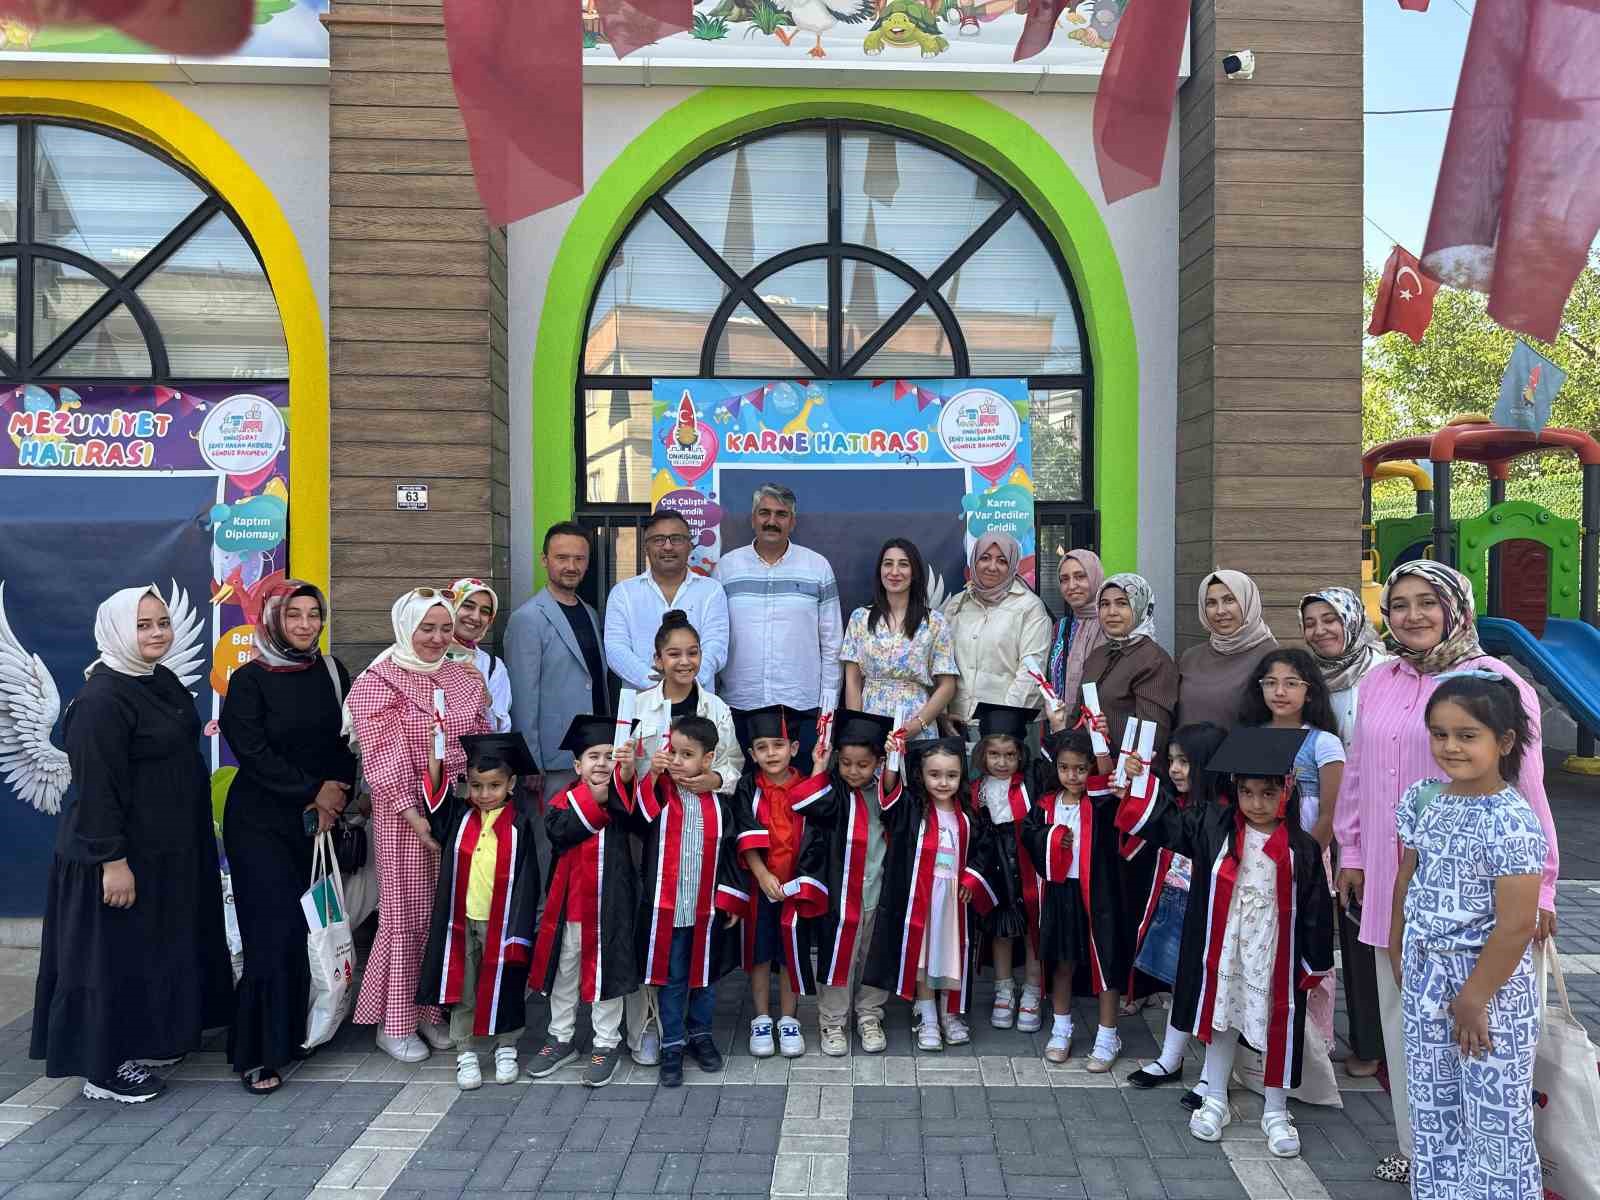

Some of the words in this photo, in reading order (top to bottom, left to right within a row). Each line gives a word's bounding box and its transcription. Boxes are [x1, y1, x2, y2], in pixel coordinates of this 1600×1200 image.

[8, 409, 173, 438] MEZUNİYET
[727, 429, 810, 454] KARNE
[815, 429, 929, 455] HATIRASI
[19, 440, 155, 467] HATIRASI
[406, 491, 419, 502] 63
[661, 498, 677, 507] Çok
[987, 499, 1016, 508] Karne
[975, 511, 993, 520] Var
[994, 511, 1030, 520] Dediler
[233, 516, 272, 527] Kaptım
[225, 530, 279, 540] Diplomayı
